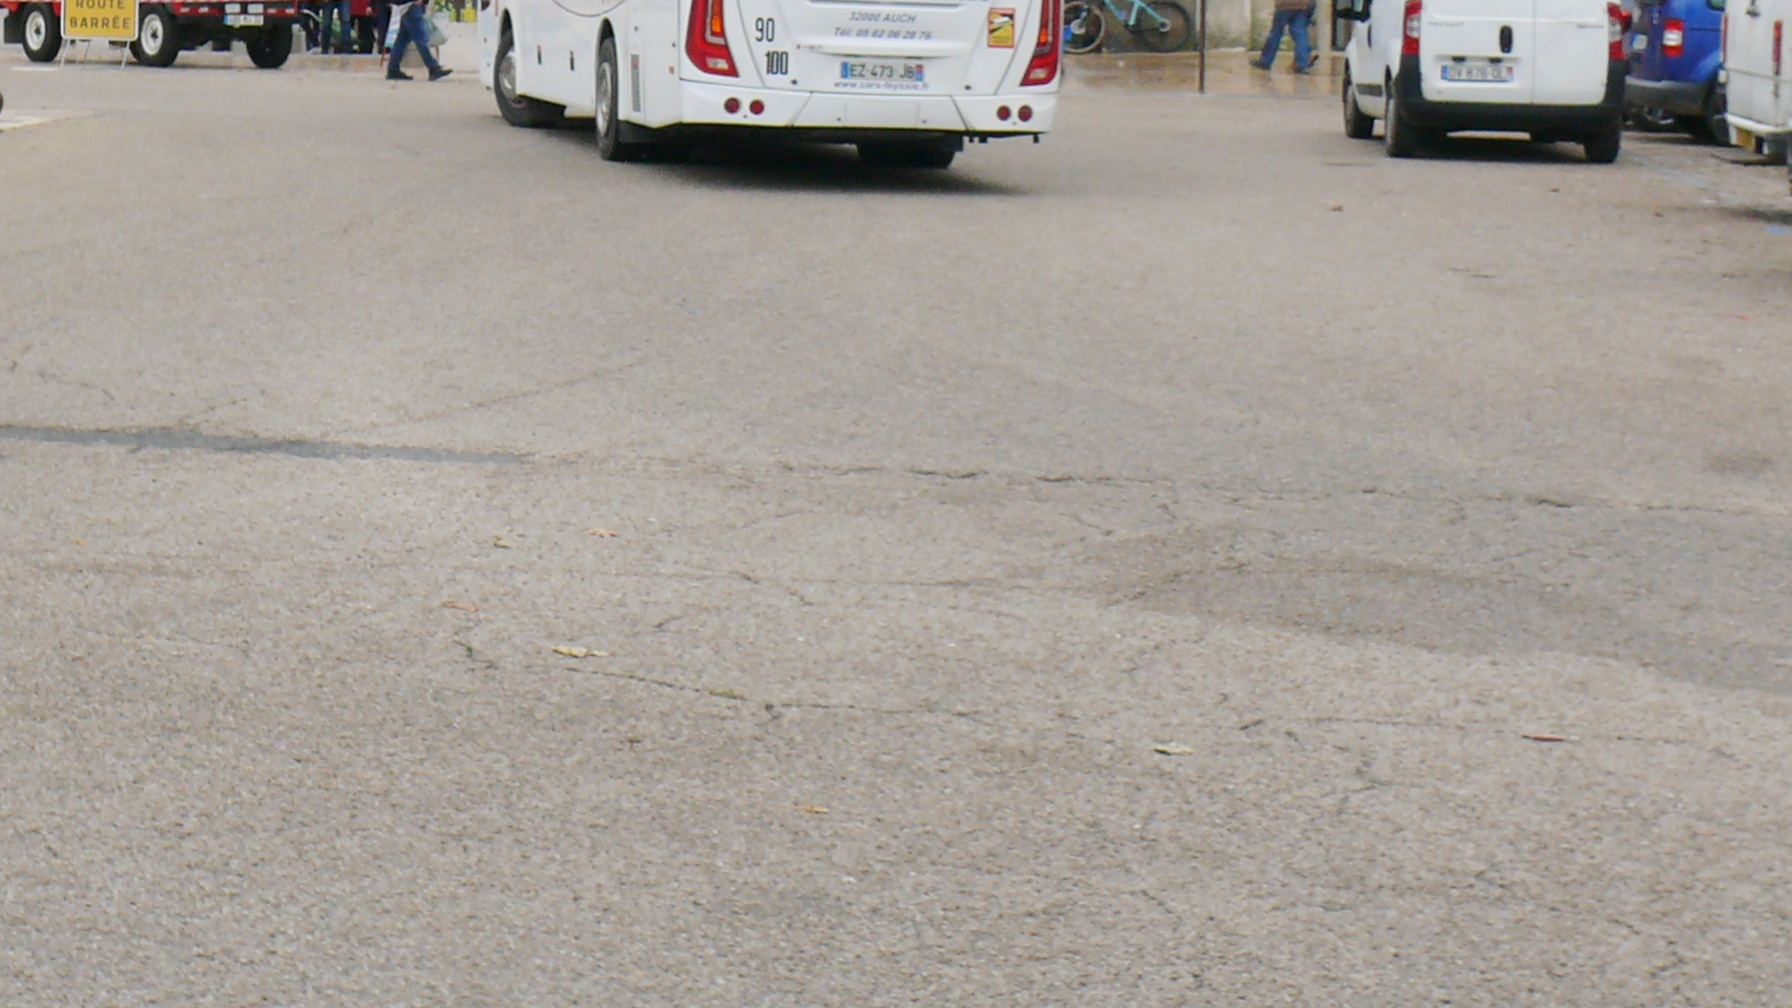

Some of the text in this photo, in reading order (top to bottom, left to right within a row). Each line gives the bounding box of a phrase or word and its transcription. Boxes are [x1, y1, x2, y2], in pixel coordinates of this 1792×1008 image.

[69, 15, 131, 30] BARRÉE
[848, 11, 917, 23] 32000 AUCH
[754, 17, 776, 42] 90
[856, 27, 870, 38] 05
[871, 28, 886, 39] 62
[765, 50, 789, 75] 100
